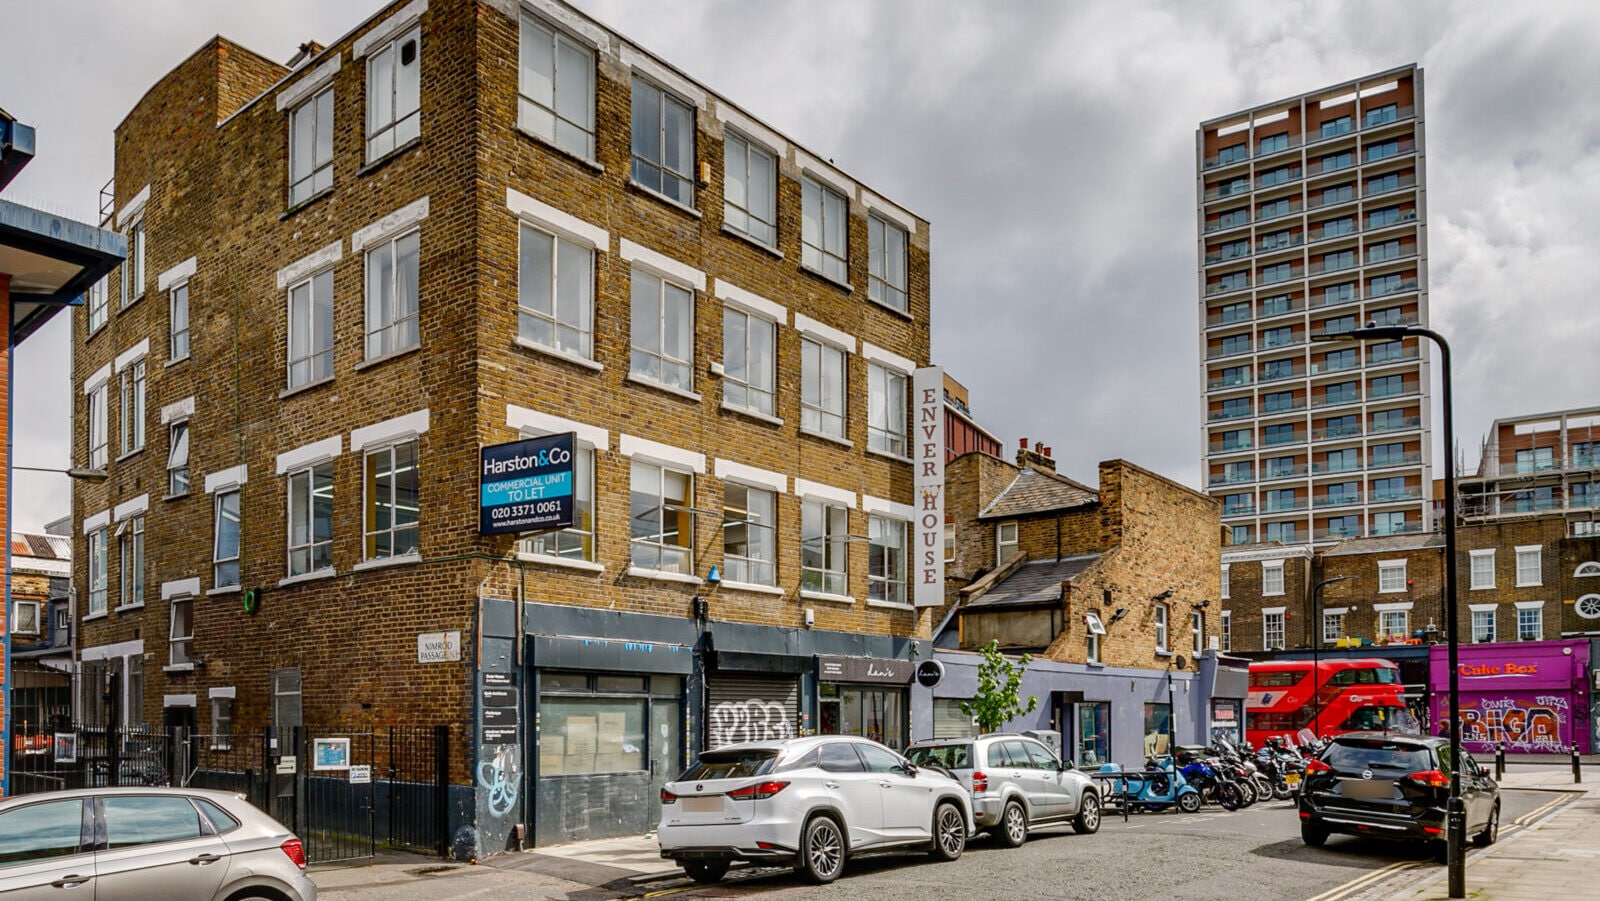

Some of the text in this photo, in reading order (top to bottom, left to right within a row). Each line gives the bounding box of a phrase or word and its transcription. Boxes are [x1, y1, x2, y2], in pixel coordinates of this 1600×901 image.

[484, 447, 571, 475] Harston&Co
[487, 473, 566, 493] COMMERCIAL UNIT
[921, 388, 938, 584] ENVER HOUSE
[508, 487, 545, 502] TO LET
[492, 500, 561, 519] 020 3371 0061
[425, 641, 453, 651] NIMROD
[421, 650, 448, 661] PASSAGE
[1459, 663, 1537, 676] Cake Box
